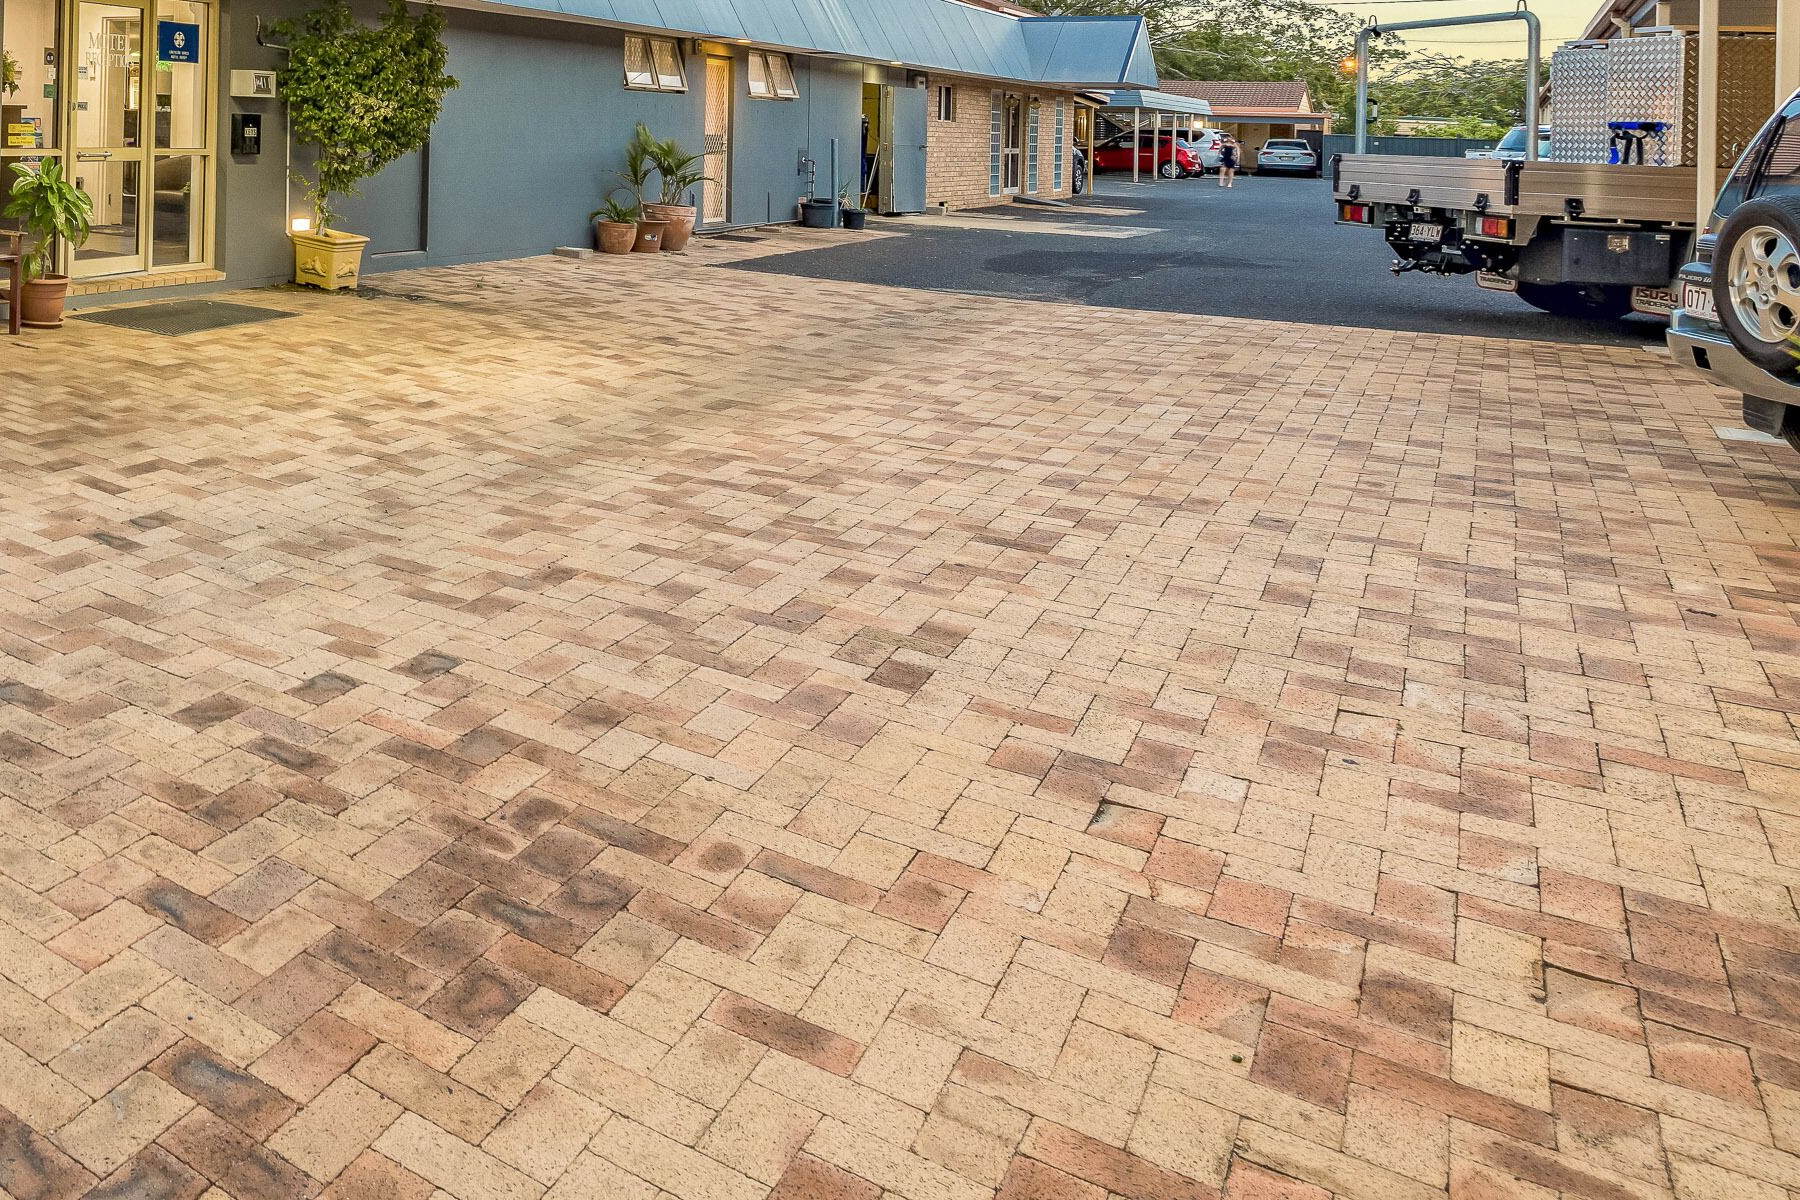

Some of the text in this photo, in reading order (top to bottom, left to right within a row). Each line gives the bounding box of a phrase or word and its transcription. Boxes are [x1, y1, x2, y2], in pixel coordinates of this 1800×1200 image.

[88, 31, 131, 51] MOTEL
[85, 52, 137, 68] RECEPTIO
[1636, 287, 1679, 303] ISUZU
[1635, 298, 1680, 309] TRADEPACK
